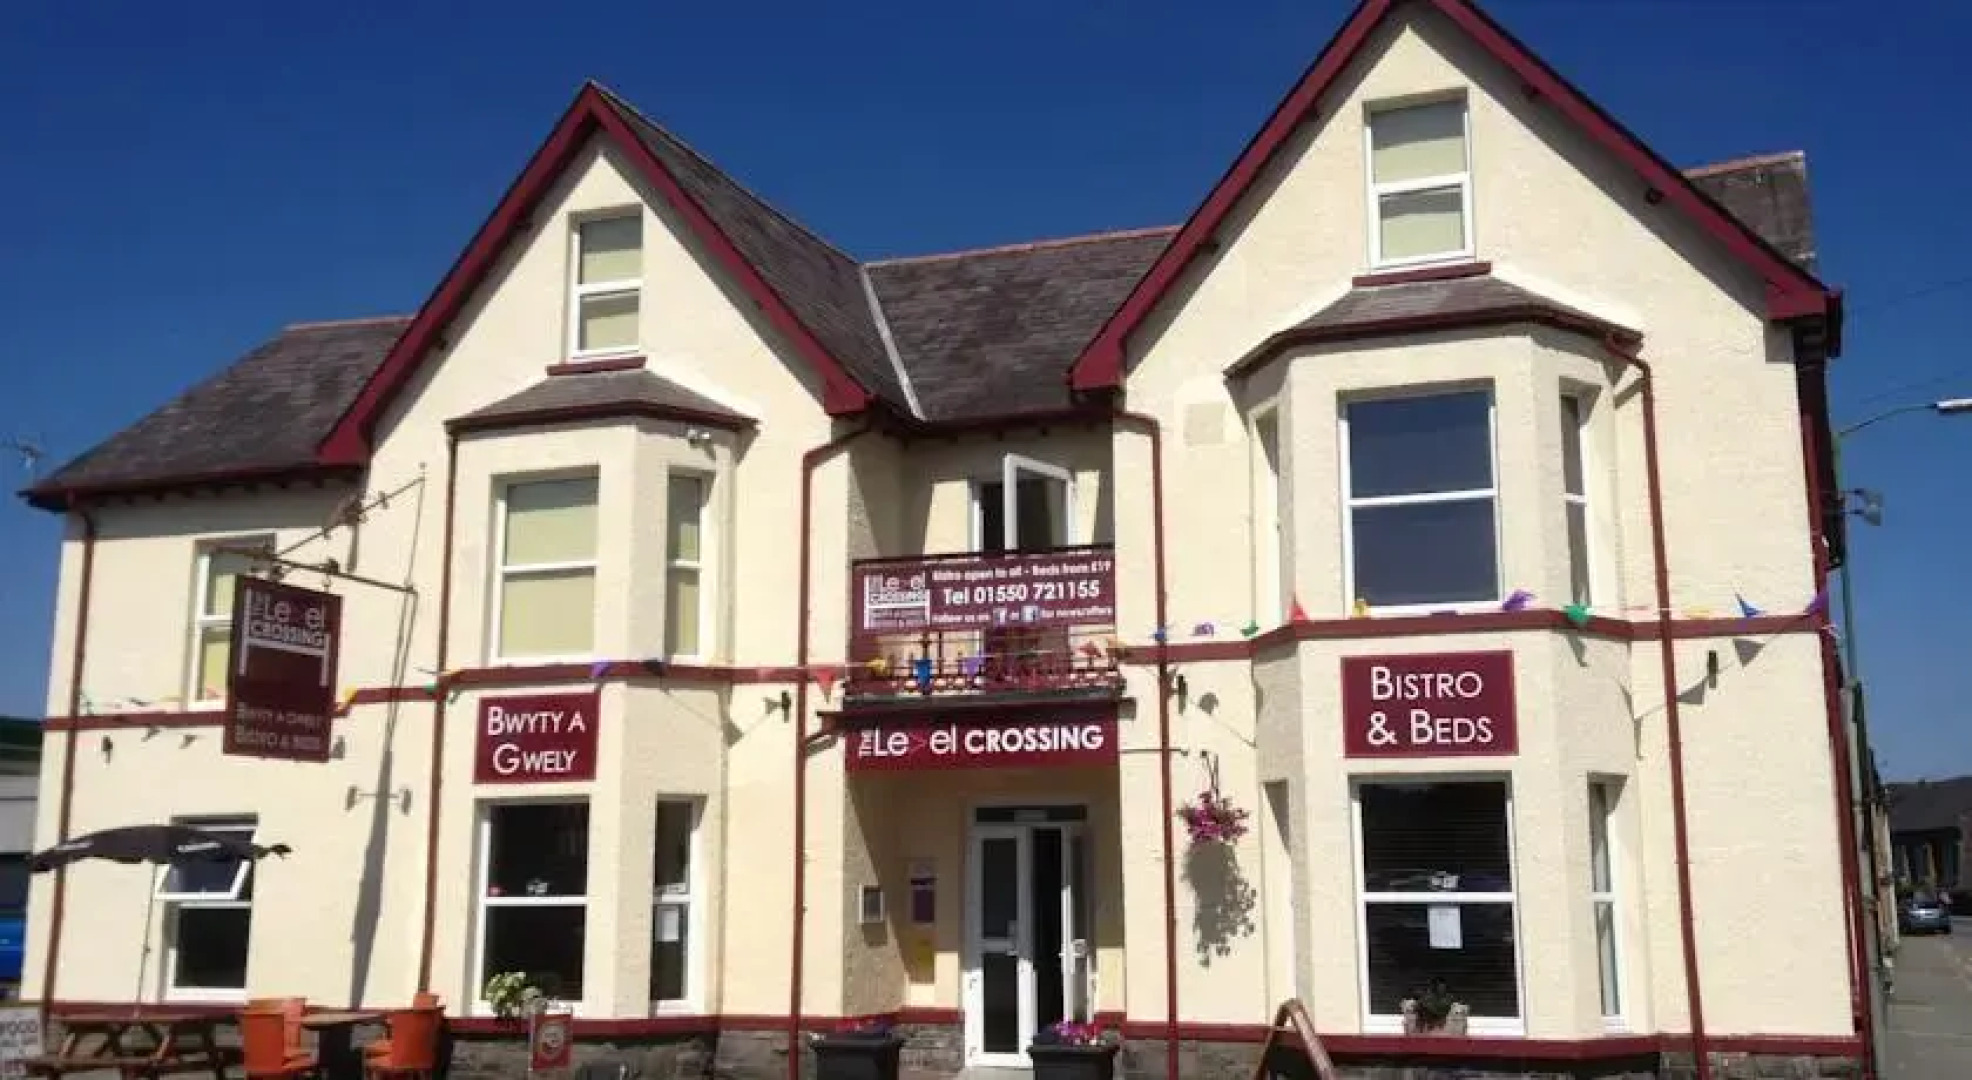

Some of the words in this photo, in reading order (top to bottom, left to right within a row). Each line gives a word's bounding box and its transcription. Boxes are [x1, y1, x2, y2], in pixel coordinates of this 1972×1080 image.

[943, 586, 970, 604] Tel
[973, 584, 1027, 603] 01550
[1032, 580, 1100, 600] 721155
[567, 710, 586, 733] A
[1367, 710, 1398, 745] &
[964, 724, 1105, 755] CROSSING
